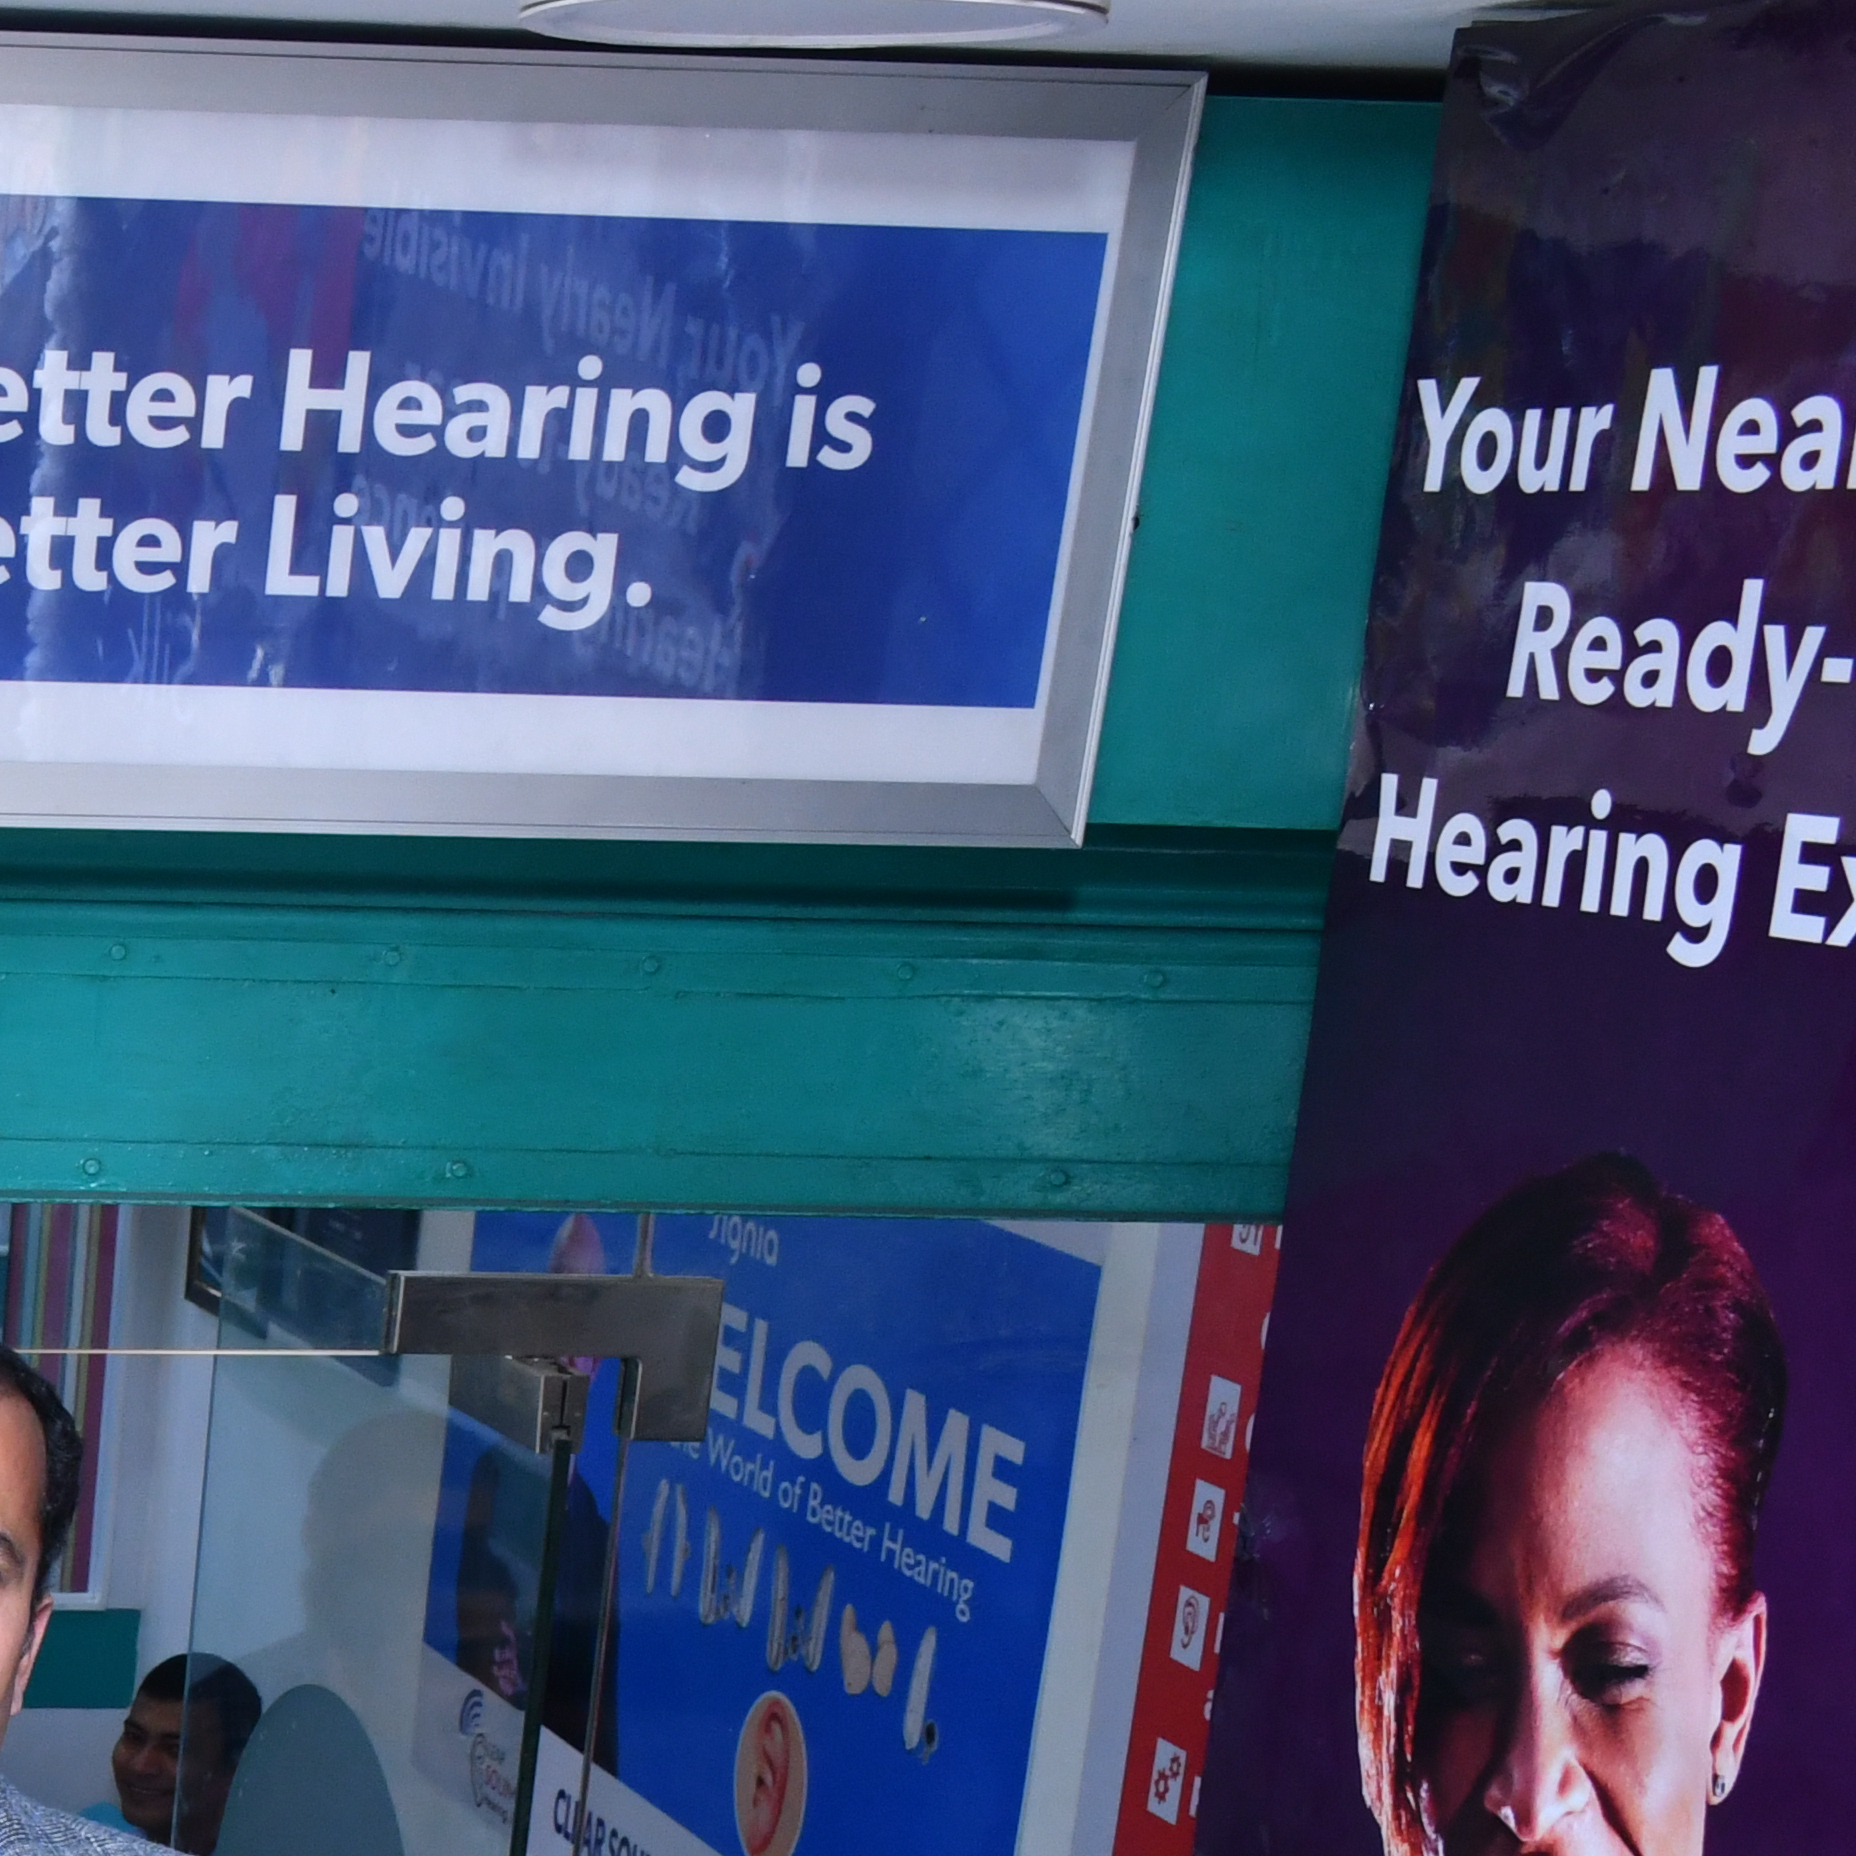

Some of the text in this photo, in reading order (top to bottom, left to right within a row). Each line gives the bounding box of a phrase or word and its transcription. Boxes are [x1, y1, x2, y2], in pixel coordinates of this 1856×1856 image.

[280, 348, 756, 492] Hearing
[787, 363, 875, 470] is
[1418, 366, 1856, 494] Your Nea
[265, 493, 652, 631] Living.
[1506, 579, 1853, 756] Ready-
[1370, 773, 1742, 968] Hearing
[709, 1301, 1026, 1564] ELCOME
[708, 1427, 975, 1623] World of Better Hearing
